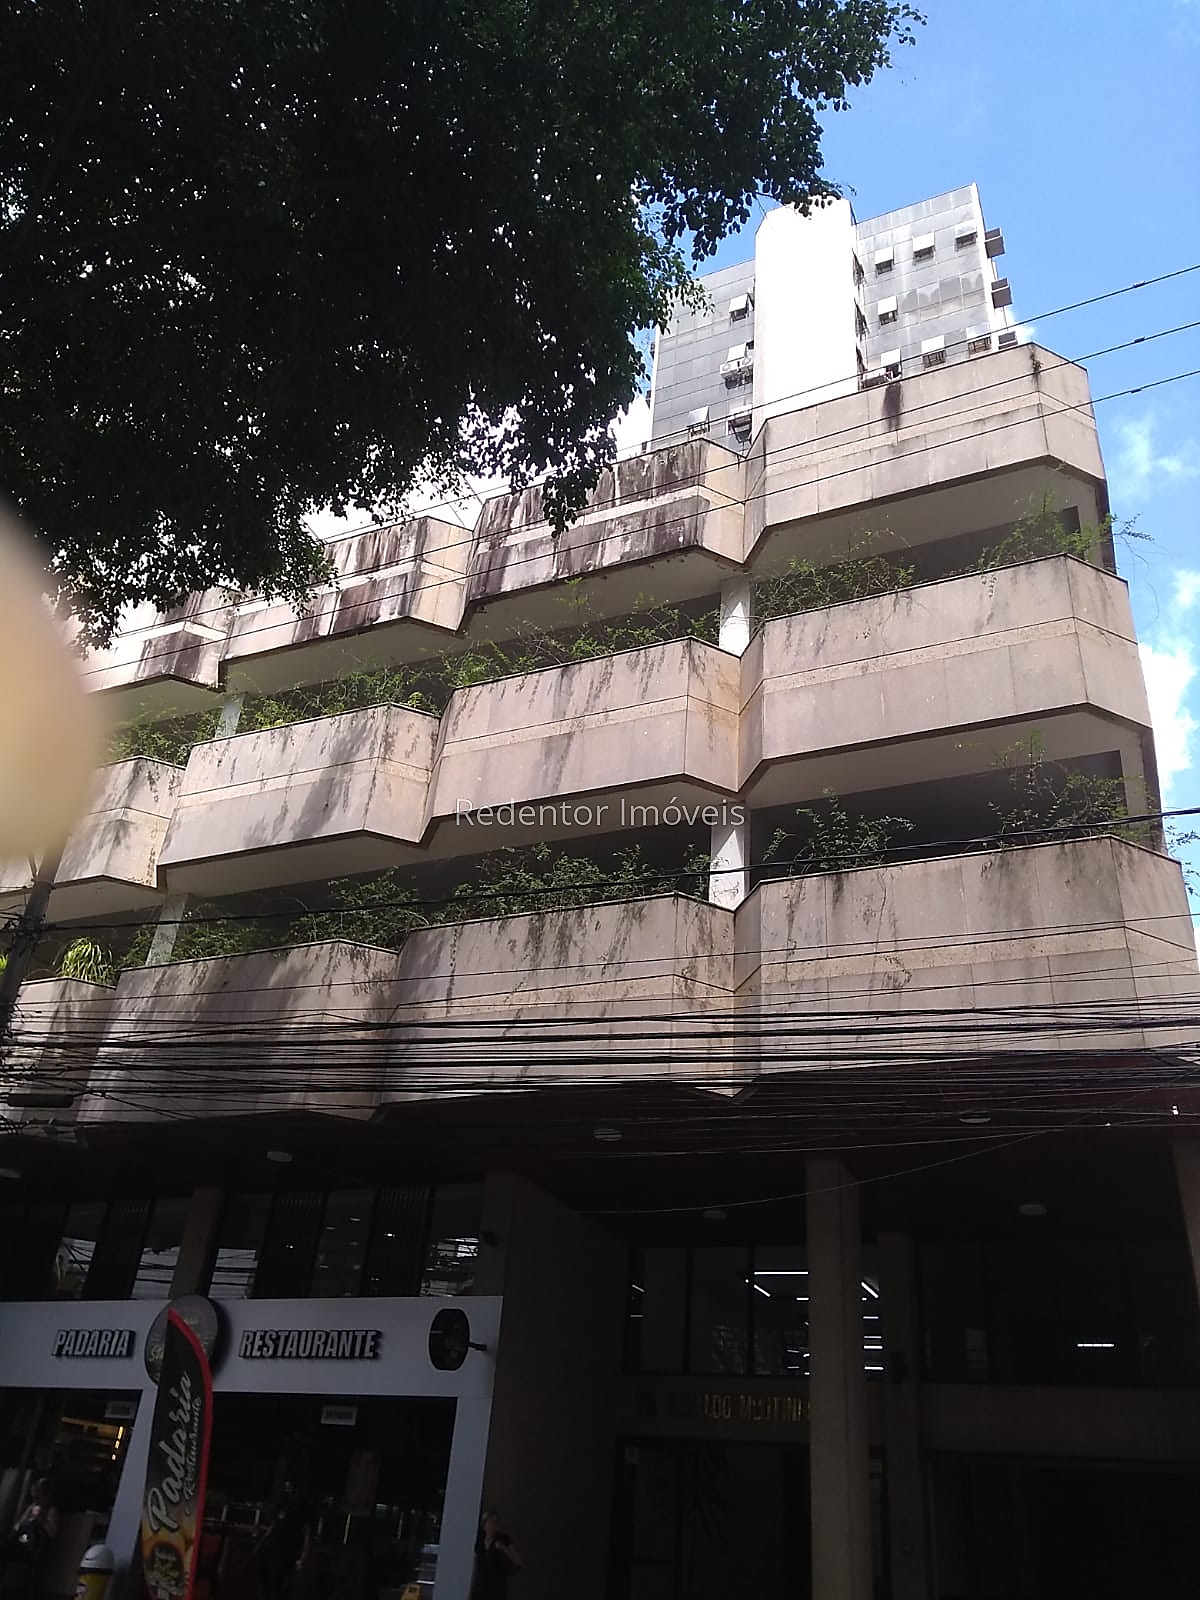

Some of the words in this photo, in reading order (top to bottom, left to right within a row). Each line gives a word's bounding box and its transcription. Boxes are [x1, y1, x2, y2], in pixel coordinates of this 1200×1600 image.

[55, 1328, 135, 1358] PADARIA
[239, 1328, 381, 1359] RESTAURANTE
[147, 1371, 192, 1532] Padaria
